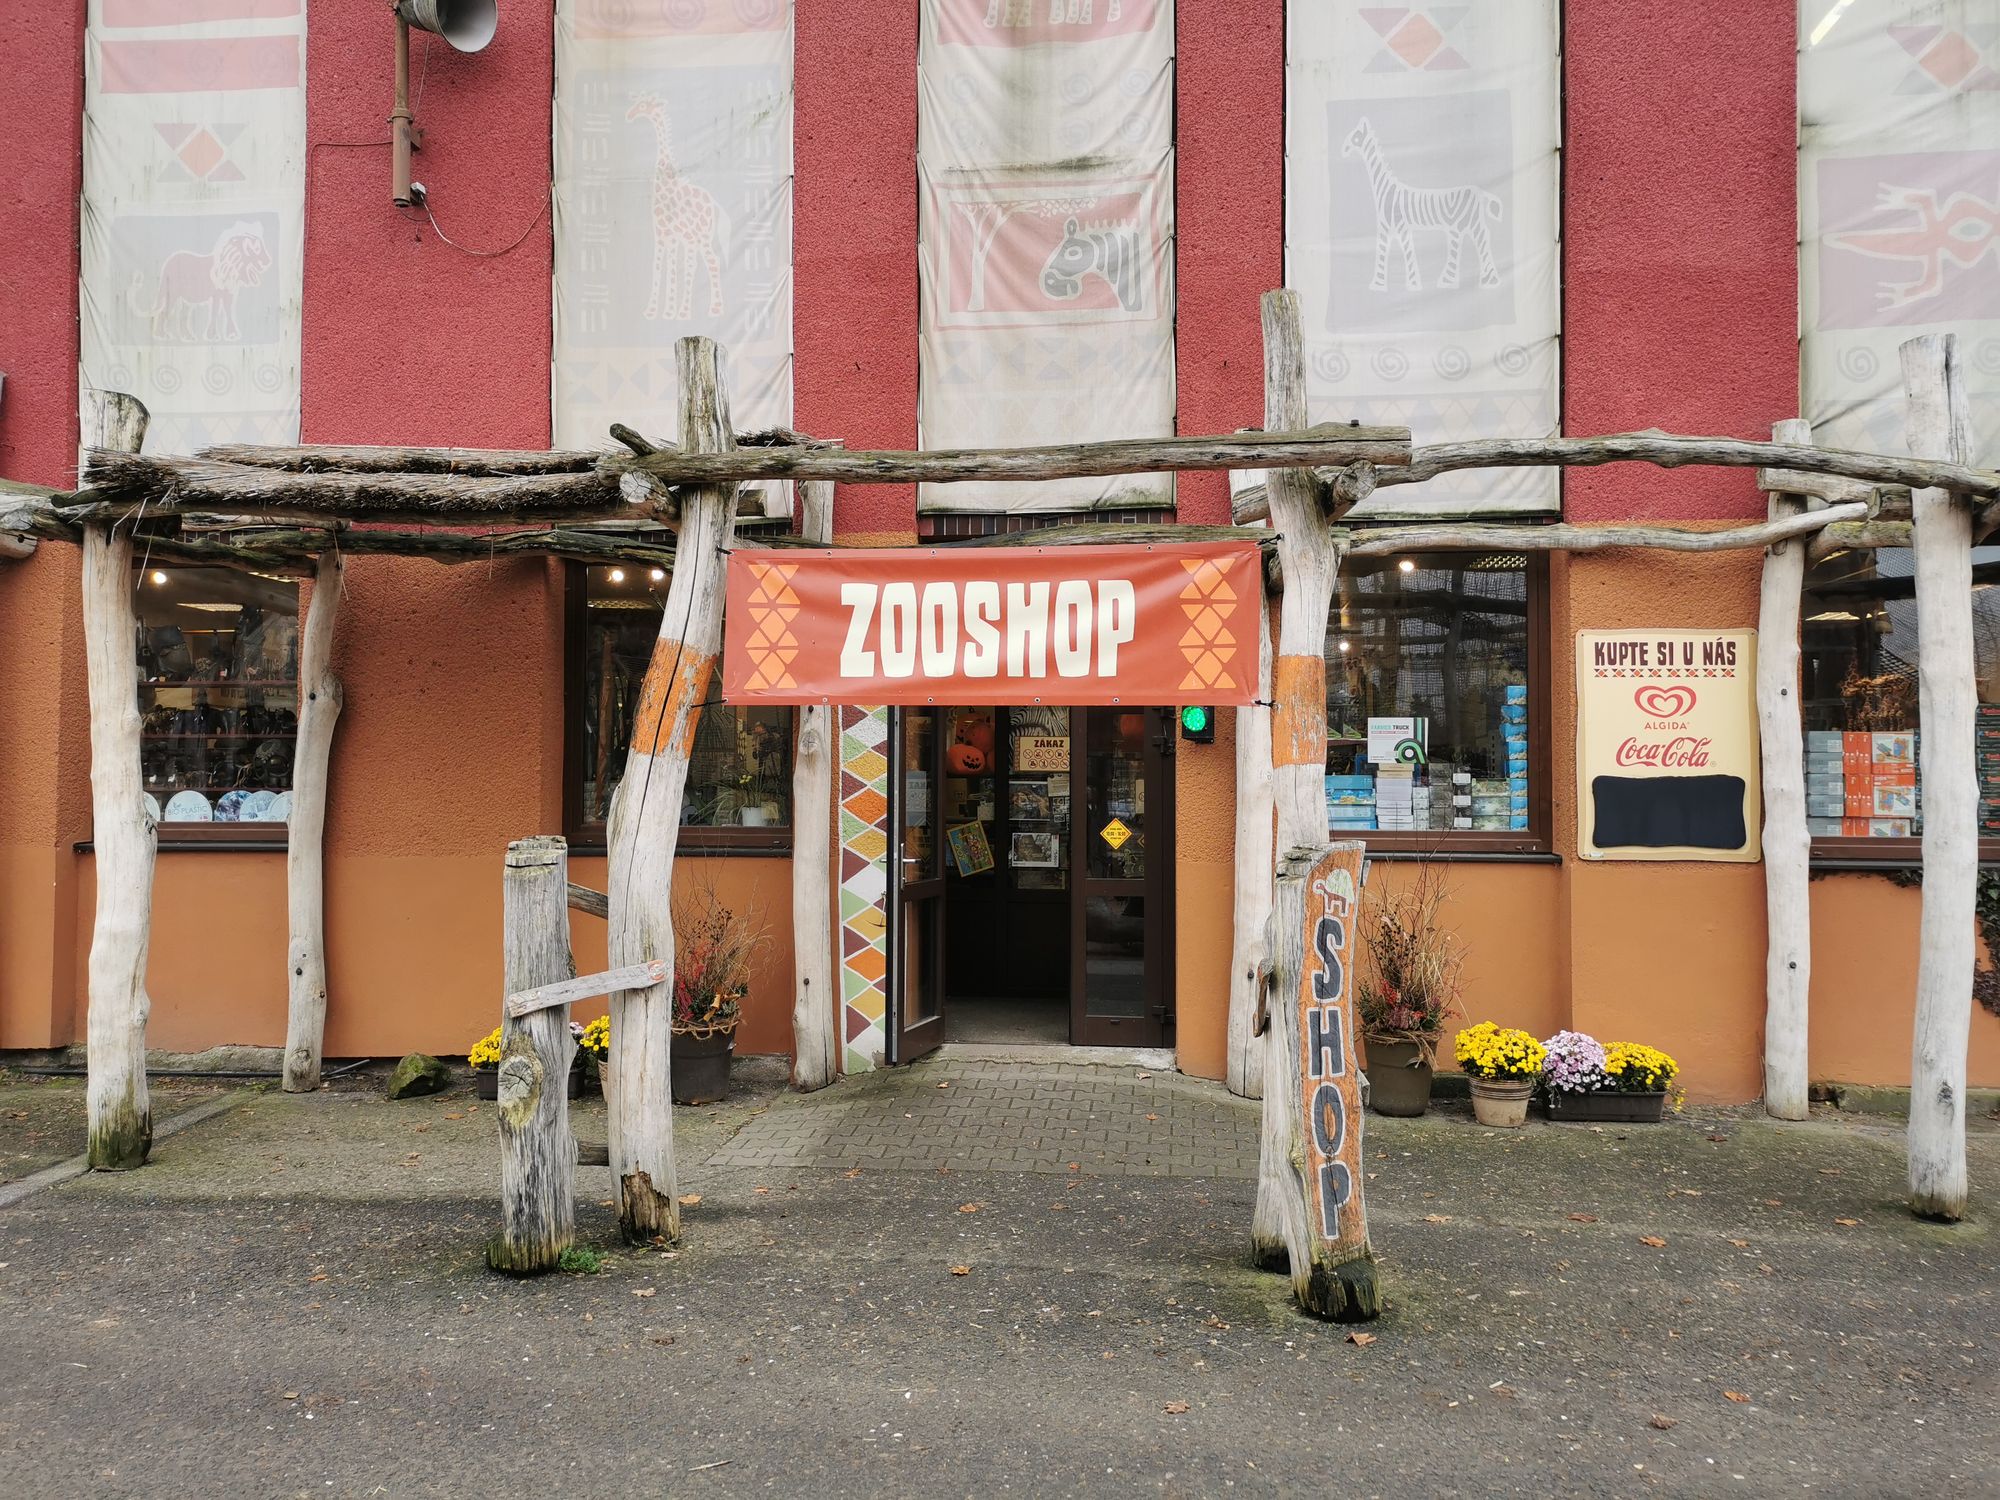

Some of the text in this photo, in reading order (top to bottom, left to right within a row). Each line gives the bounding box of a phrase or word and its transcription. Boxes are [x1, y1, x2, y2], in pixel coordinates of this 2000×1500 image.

[840, 579, 1136, 679] ZOOSHOP
[1594, 637, 1736, 666] KUPTE SI U NÁS
[1644, 721, 1688, 730] ALGIDA
[1615, 736, 1713, 768] Coca-Cola
[1306, 914, 1352, 1241] SHOP
